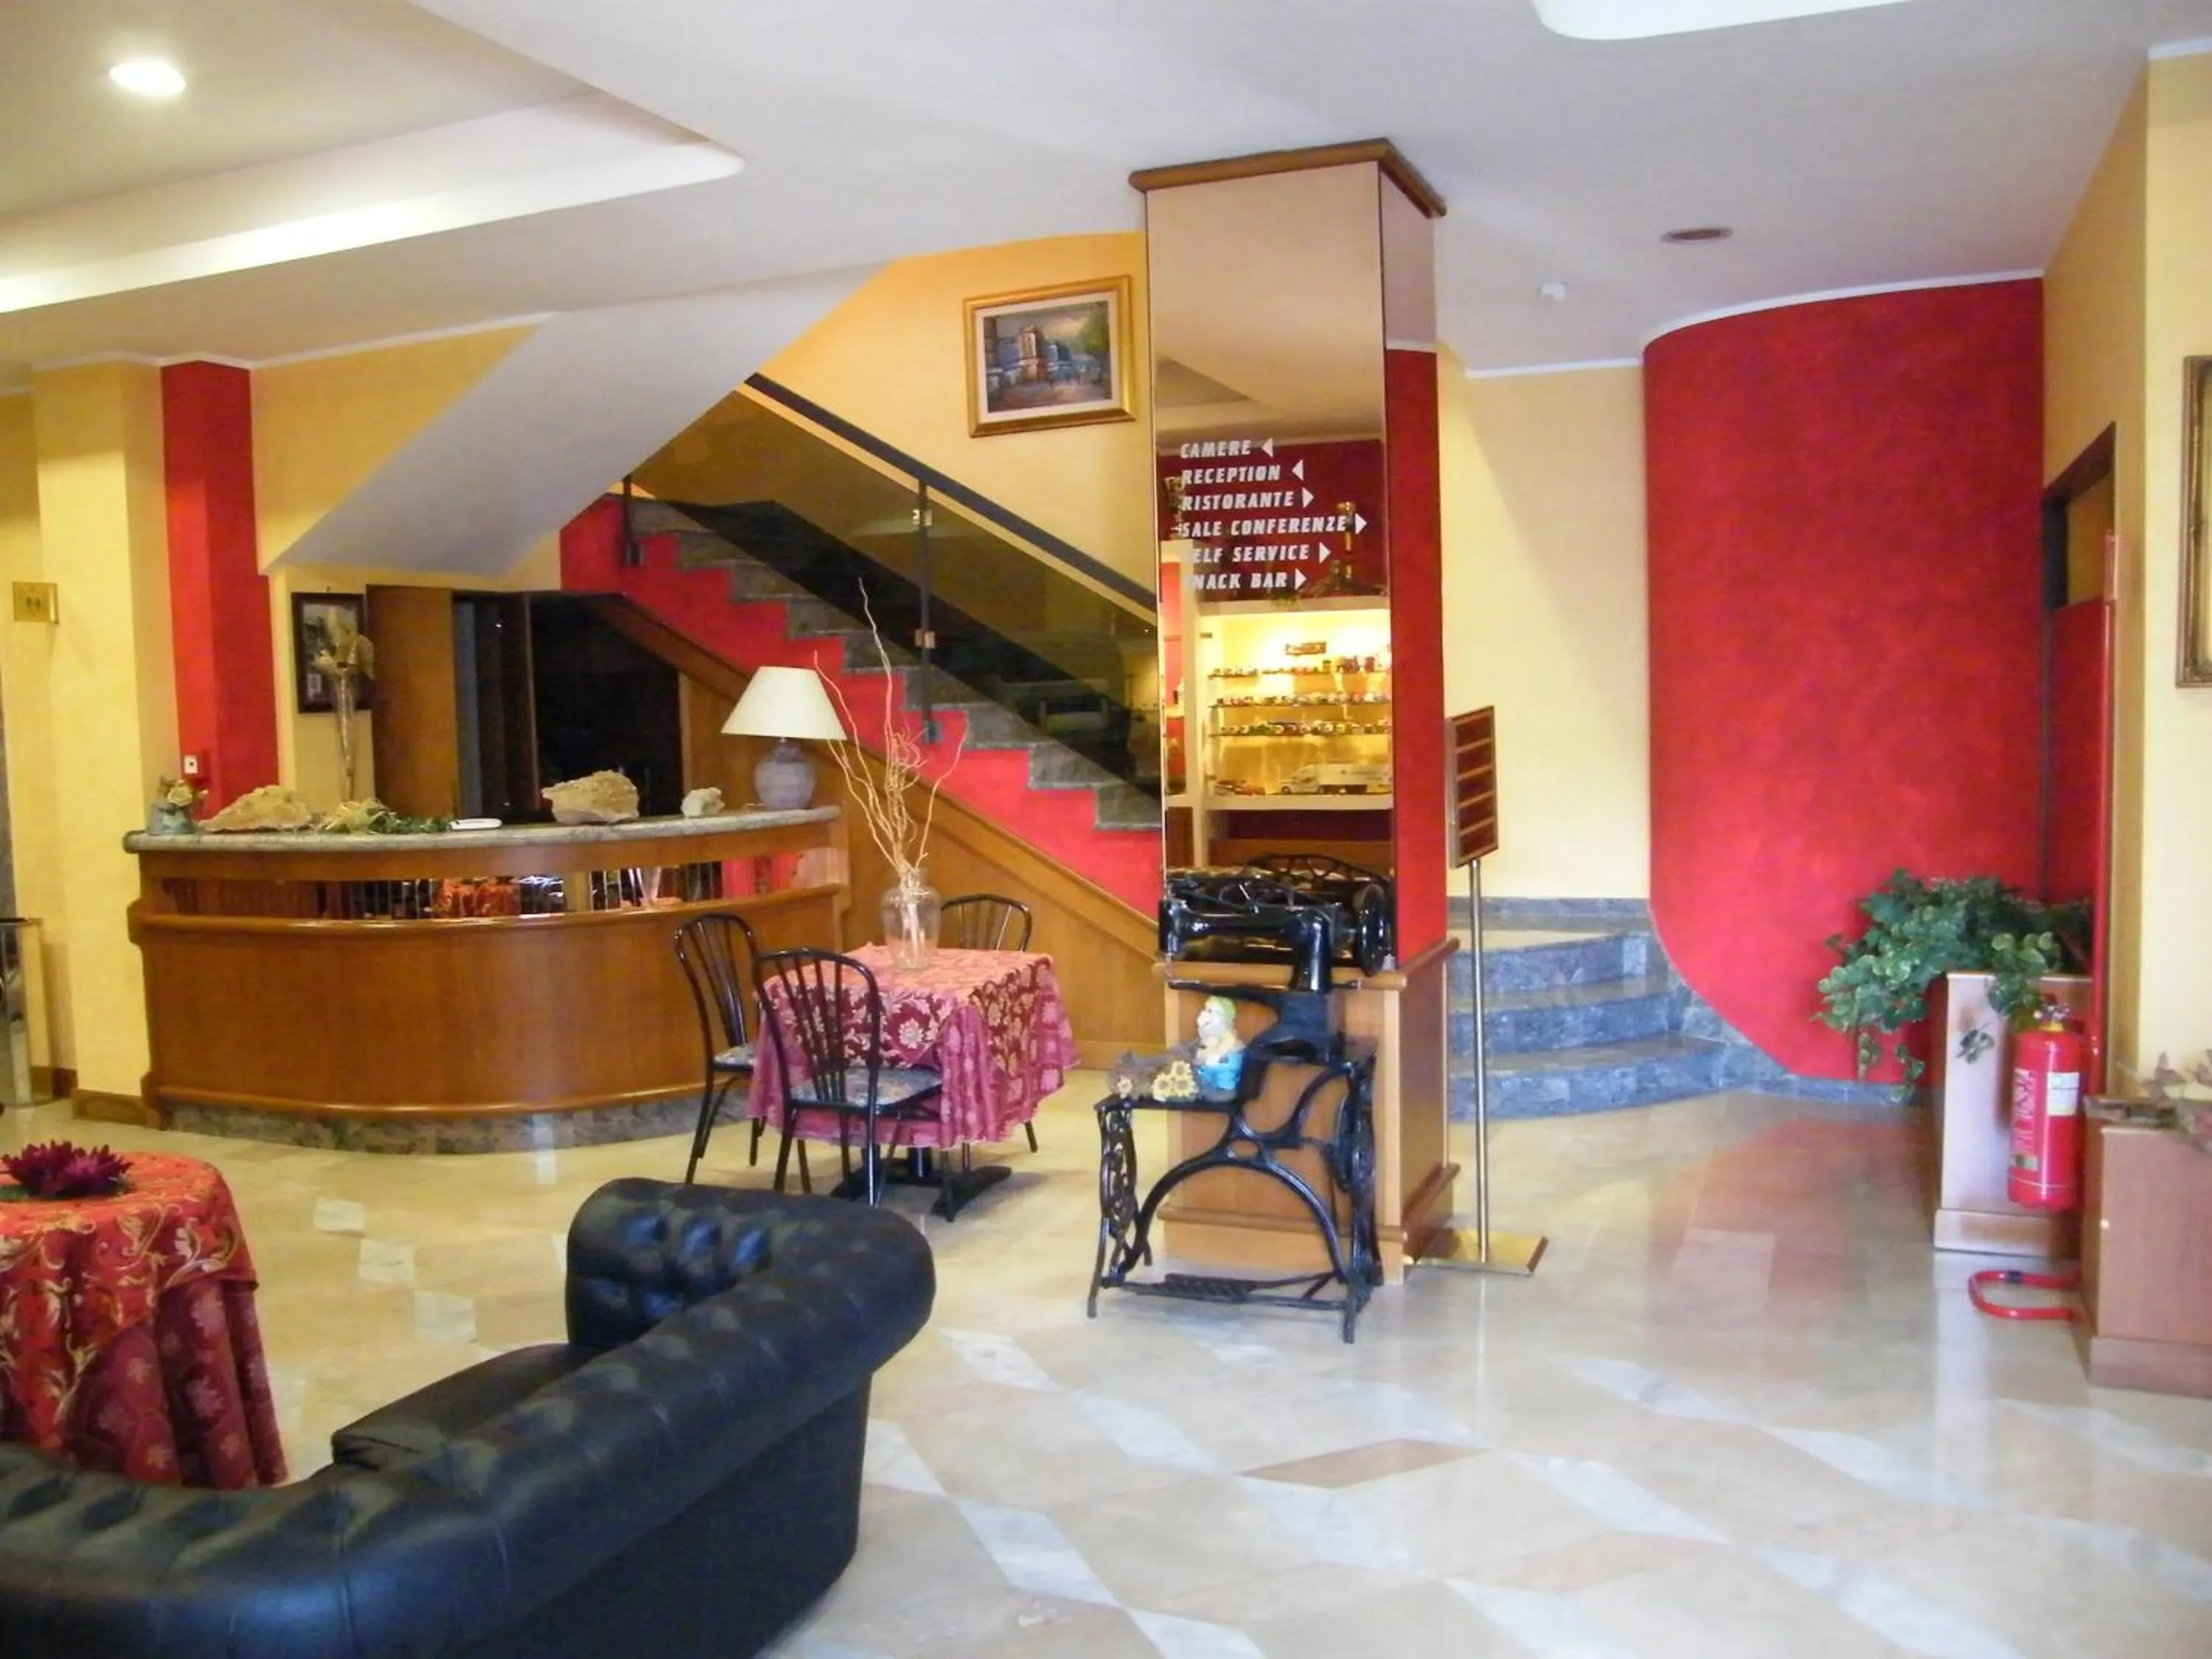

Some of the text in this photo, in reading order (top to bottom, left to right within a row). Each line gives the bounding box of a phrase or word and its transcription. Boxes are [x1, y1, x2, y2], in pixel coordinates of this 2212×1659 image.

[1180, 439, 1251, 459] CAMERE
[1181, 465, 1281, 484] RECEPTION
[1181, 491, 1294, 511] RISTORANTE
[1181, 515, 1346, 538] SALE CONFERENZE
[1183, 544, 1310, 564] ELF SERVICE
[1182, 571, 1287, 590] NACK BAR
